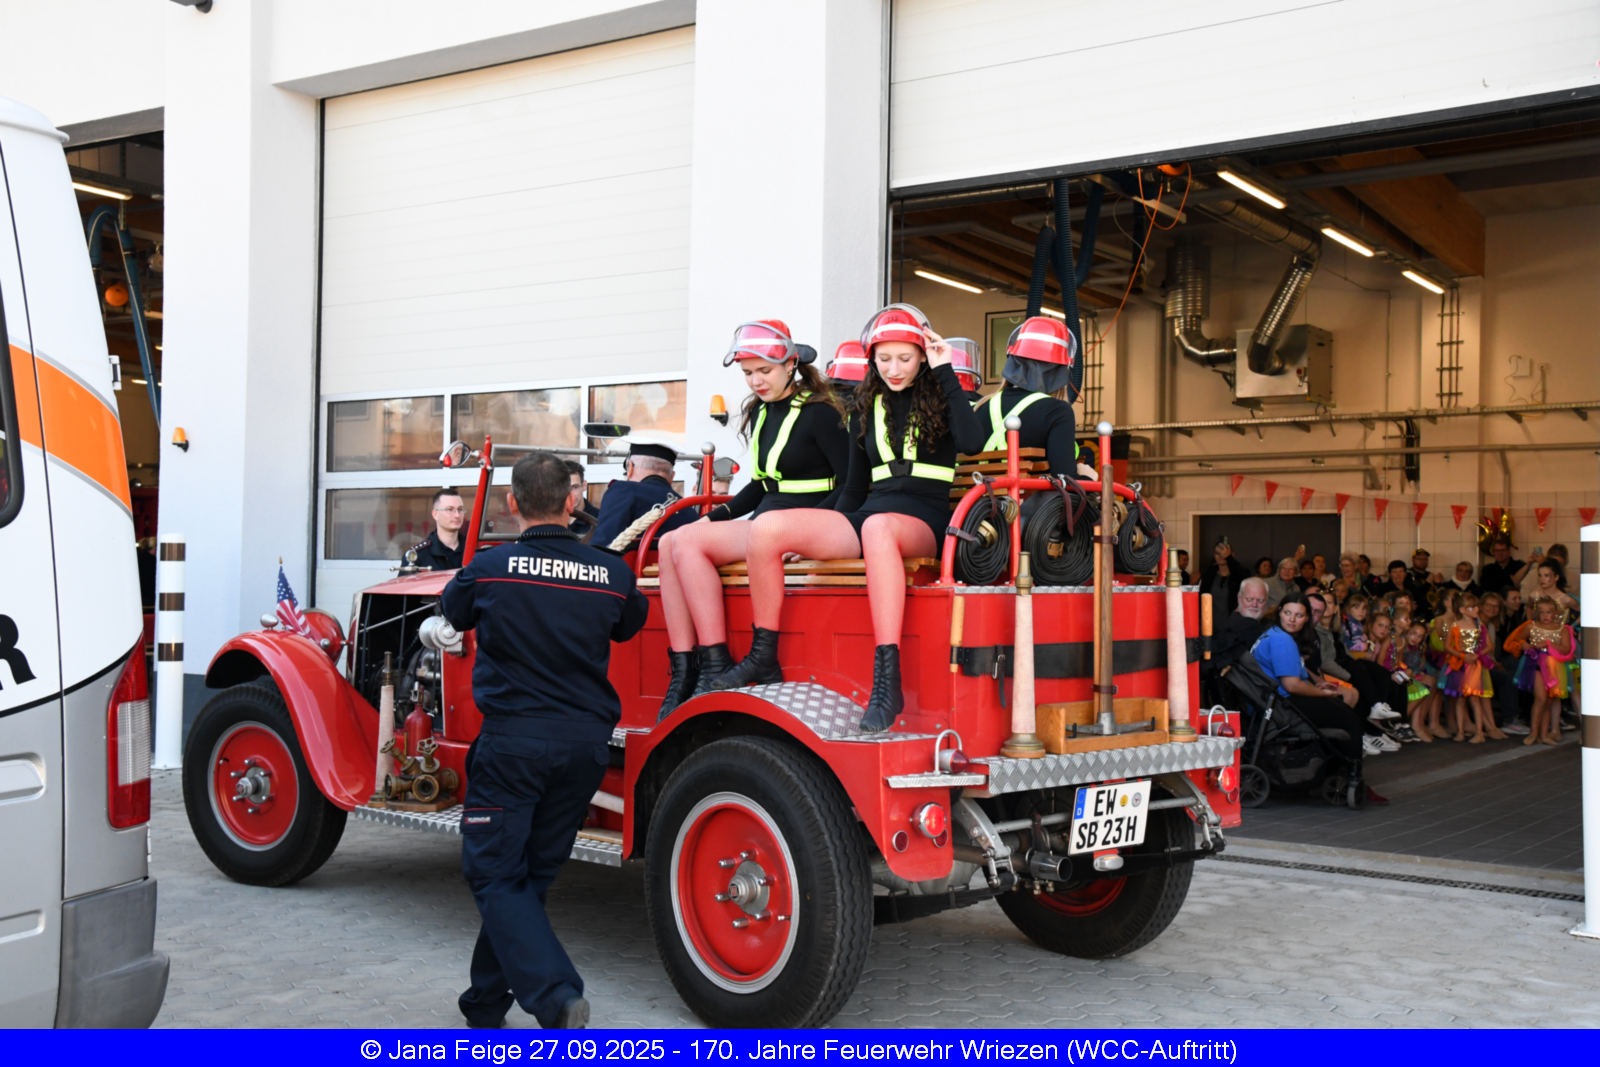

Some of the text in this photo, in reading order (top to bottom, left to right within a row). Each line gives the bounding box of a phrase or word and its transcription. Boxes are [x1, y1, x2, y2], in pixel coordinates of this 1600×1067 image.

[507, 556, 610, 585] FEUERWEHR
[1094, 788, 1117, 817] EW
[1075, 821, 1099, 850] SB
